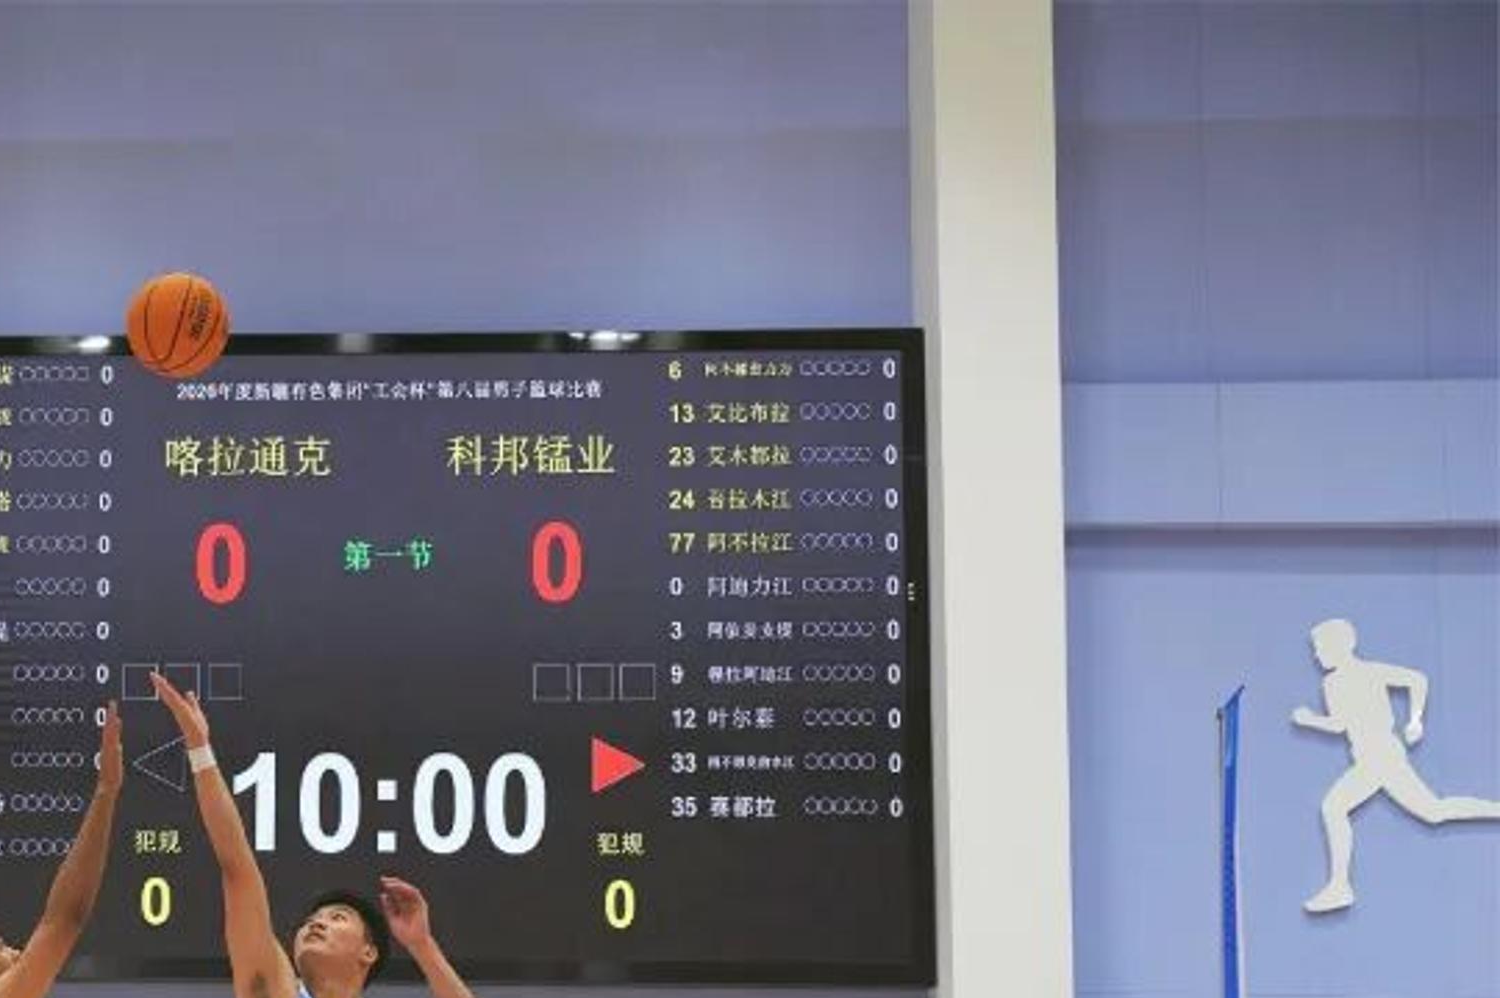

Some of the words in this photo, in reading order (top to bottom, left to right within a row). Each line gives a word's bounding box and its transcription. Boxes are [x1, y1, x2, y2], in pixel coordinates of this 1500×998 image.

[101, 366, 113, 384] 0
[669, 361, 681, 380] 6
[883, 358, 895, 378] 0
[100, 408, 112, 426] 0
[670, 404, 694, 422] 13
[883, 402, 896, 420] 0
[100, 450, 111, 467] 0
[165, 435, 331, 477] 喀拉通克
[447, 434, 616, 477] 科邦锰业
[669, 447, 695, 466] 23
[884, 444, 897, 464] 0
[99, 492, 111, 511] 0
[670, 490, 694, 509] 24
[885, 488, 898, 508] 0
[98, 535, 110, 553] 0
[670, 533, 695, 552] 77
[886, 533, 898, 551] 0
[196, 522, 246, 604] 0
[344, 540, 434, 572] 第一节
[532, 520, 582, 603] 0
[97, 578, 109, 597] 0
[670, 577, 683, 595] 0
[886, 576, 899, 595] 0
[97, 622, 109, 639] 0
[671, 622, 682, 639] 3
[887, 619, 900, 640] 0
[97, 664, 109, 683] 0
[671, 665, 683, 684] 9
[888, 664, 900, 684] 0
[96, 708, 106, 726] 0
[673, 708, 696, 728] 12
[889, 708, 901, 728] 0
[672, 753, 696, 773] 33
[889, 752, 901, 772] 0
[233, 752, 547, 854] 10:00
[672, 797, 697, 816] 35
[890, 797, 903, 817] 0
[134, 830, 182, 854] 犯规
[597, 832, 645, 856] 犯规
[140, 876, 172, 926] 0
[604, 879, 636, 929] 0
